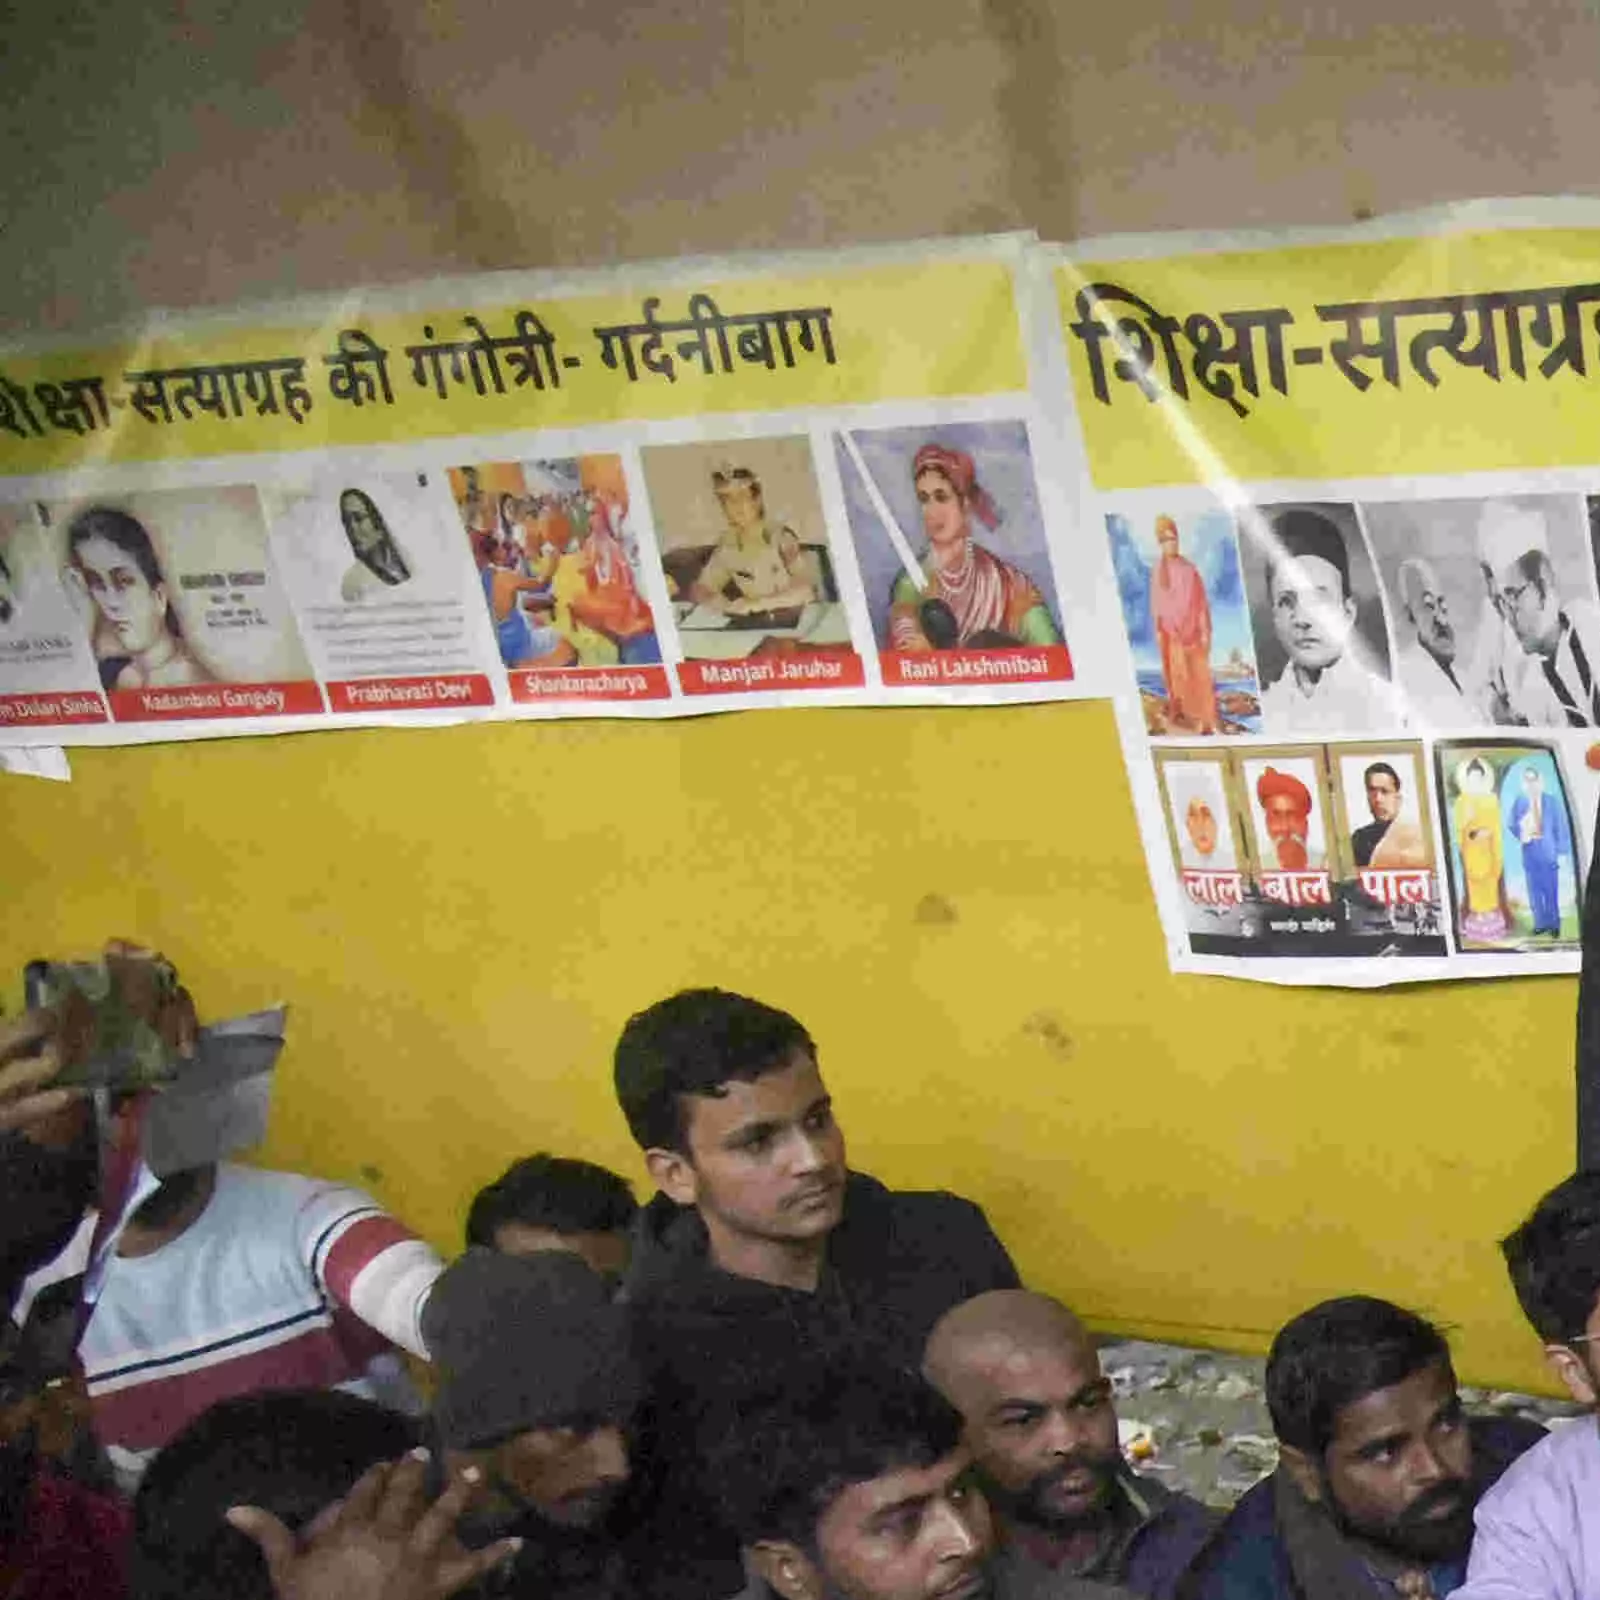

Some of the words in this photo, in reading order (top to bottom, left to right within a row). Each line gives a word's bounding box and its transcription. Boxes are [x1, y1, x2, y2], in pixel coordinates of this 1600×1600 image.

[323, 329, 394, 406] की
[405, 311, 581, 400] गंगोत्री-
[594, 293, 832, 383] गर्दनीबाग
[702, 658, 774, 686] Manjari
[900, 658, 939, 681] Rani
[943, 654, 1050, 679] Lakshmibai
[346, 682, 433, 703] Prabhavati
[436, 680, 471, 699] Devi
[526, 673, 647, 695] Shankaracharya
[1184, 869, 1243, 904] लाल
[1261, 869, 1331, 904] बाल
[1359, 868, 1433, 904] पाल
